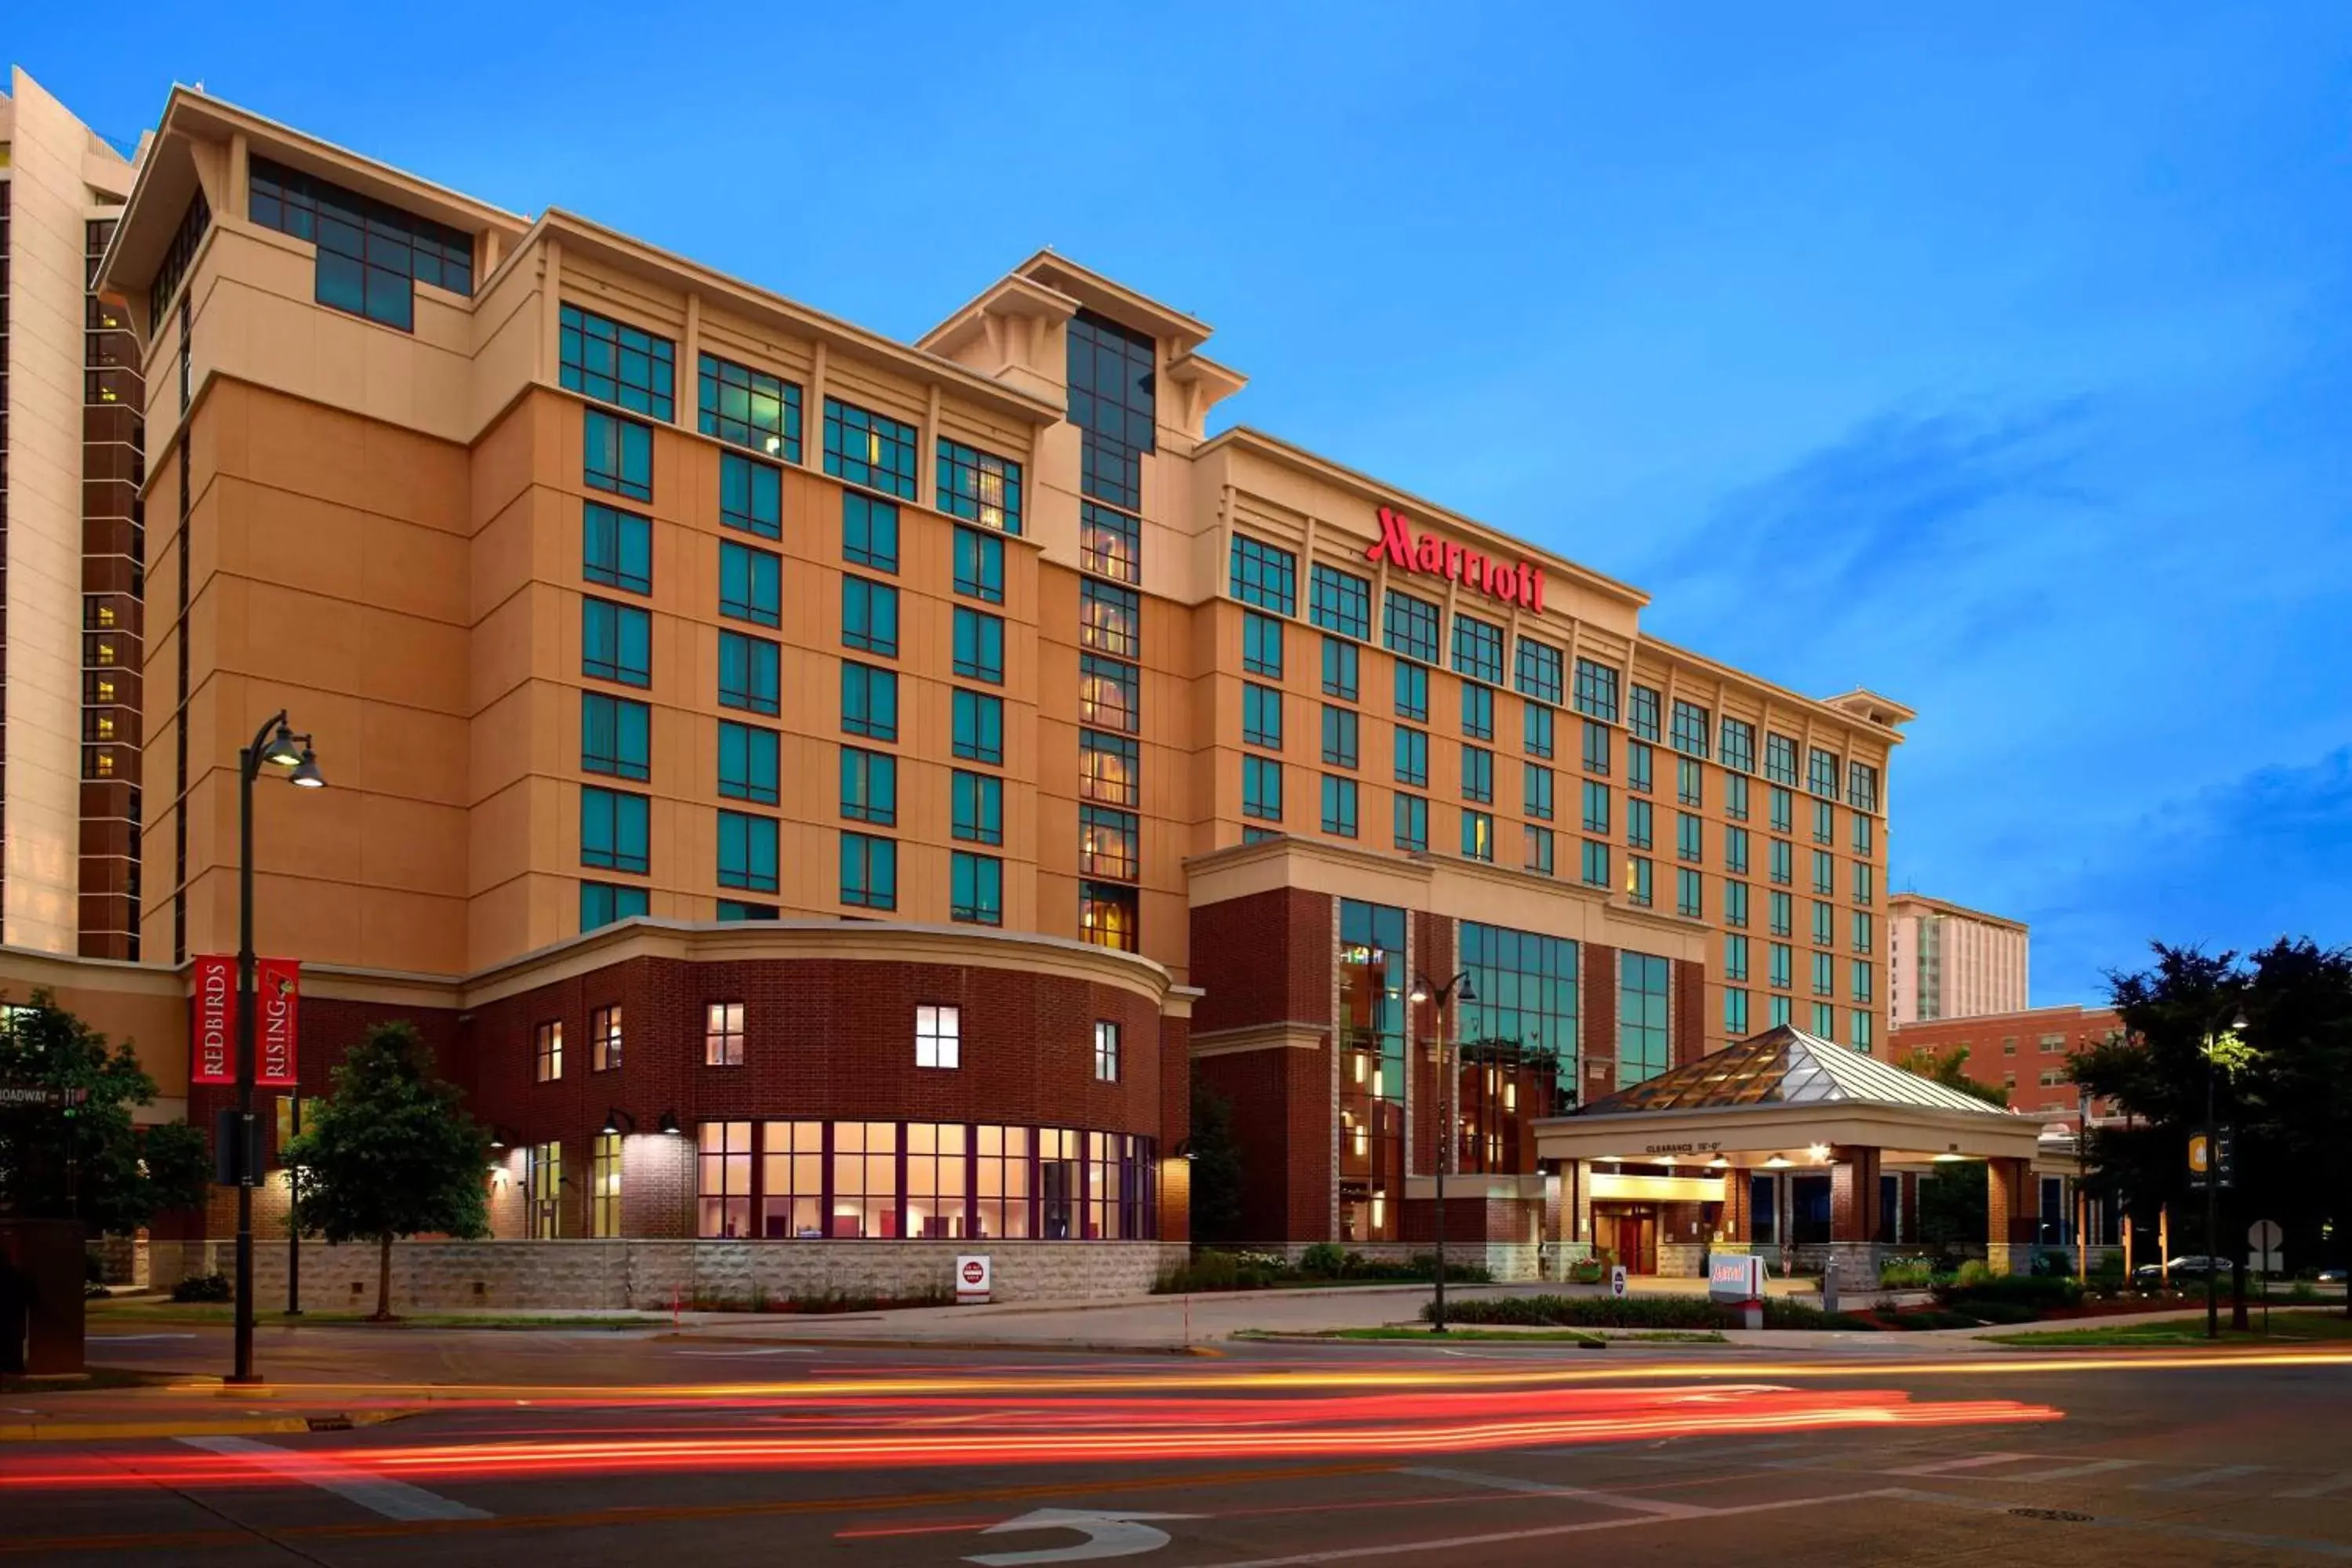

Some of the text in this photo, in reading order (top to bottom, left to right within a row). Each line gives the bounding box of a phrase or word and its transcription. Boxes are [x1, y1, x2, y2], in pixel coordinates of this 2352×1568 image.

[1365, 504, 1546, 615] Marriott
[205, 964, 226, 1076] REDBIRDS
[267, 1000, 287, 1078] RISING
[0, 1088, 46, 1104] OADWAY
